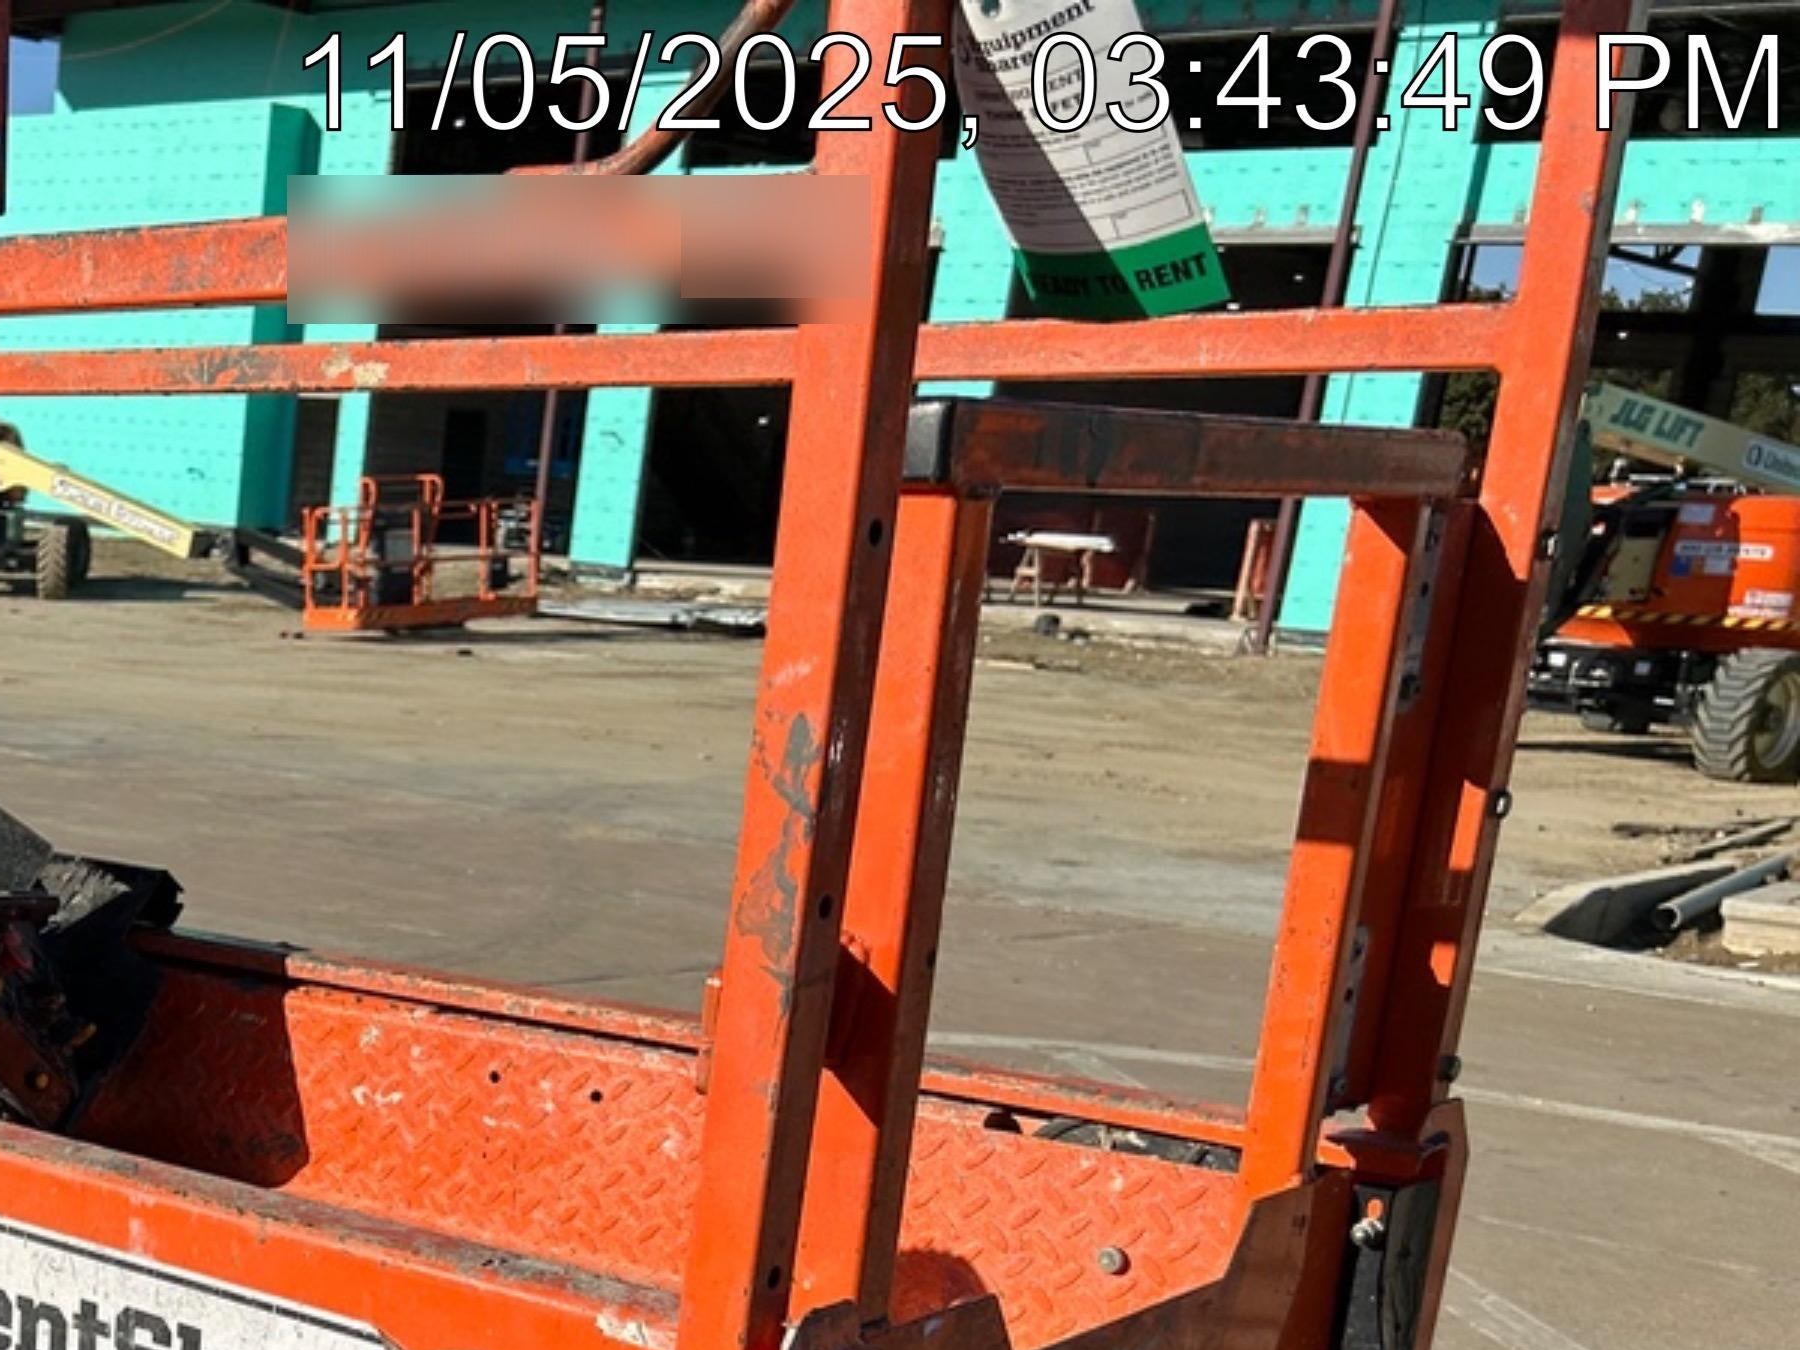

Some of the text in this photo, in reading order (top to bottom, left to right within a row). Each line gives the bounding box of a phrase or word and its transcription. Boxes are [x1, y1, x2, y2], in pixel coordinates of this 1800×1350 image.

[1134, 252, 1207, 291] RENT
[1609, 397, 1705, 447] JLG LIFT
